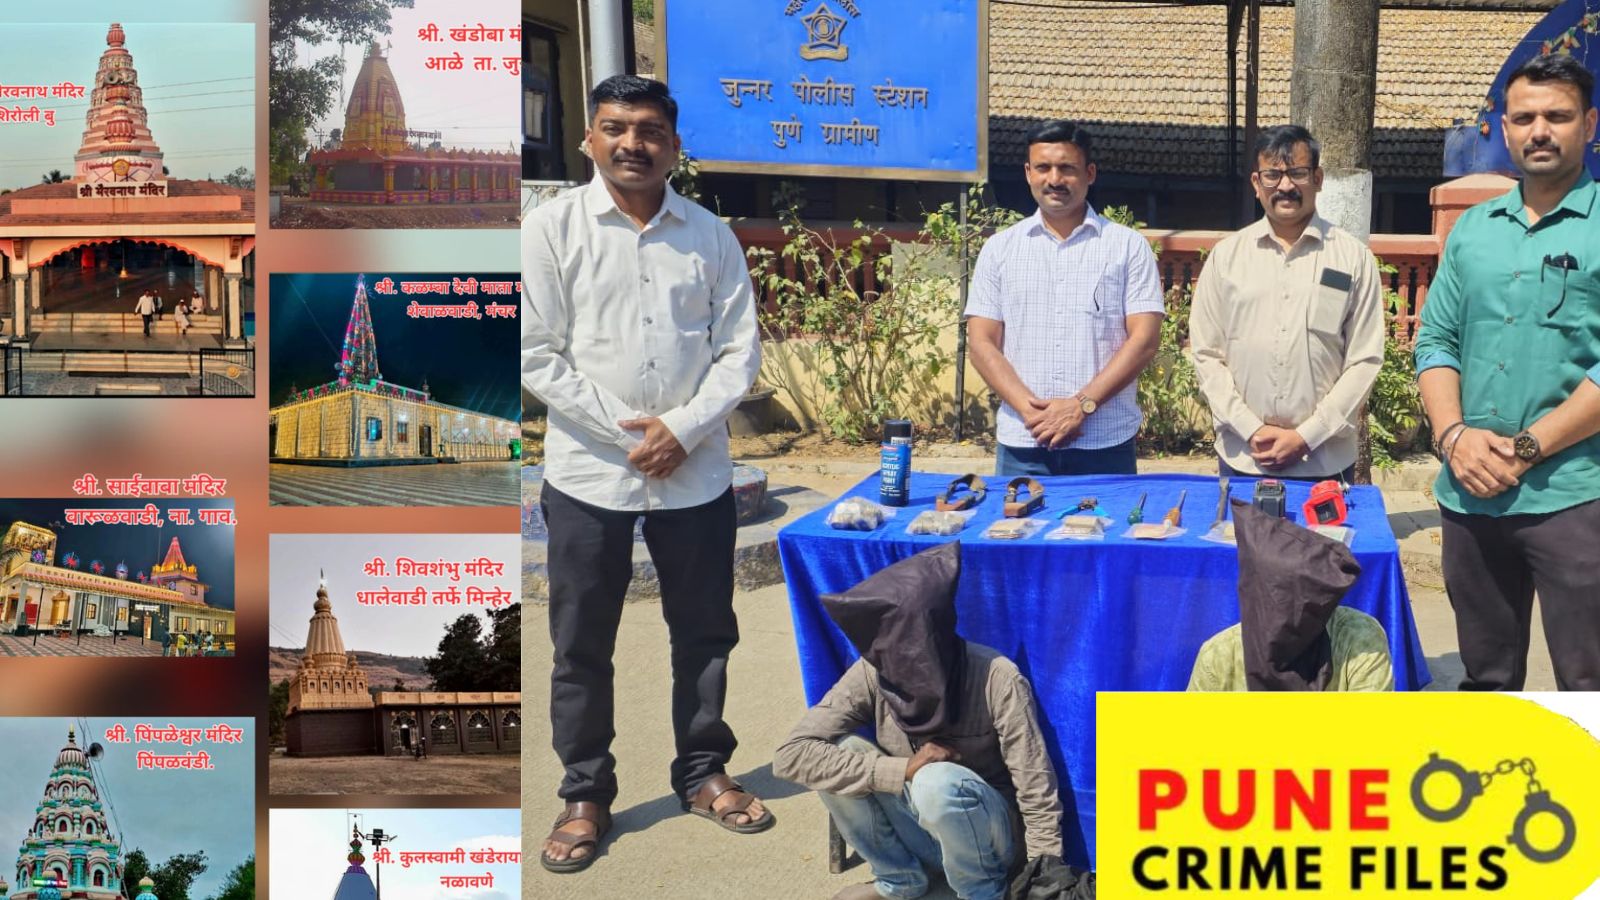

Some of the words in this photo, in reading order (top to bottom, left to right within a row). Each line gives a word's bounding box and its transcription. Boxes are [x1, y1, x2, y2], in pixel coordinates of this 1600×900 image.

[720, 77, 773, 108] जुन्नर
[791, 73, 855, 106] पोलीस
[872, 78, 929, 109] स्टेशन
[769, 115, 803, 148] पुणे
[819, 118, 880, 147] ग्रामीण
[139, 182, 165, 196] मंदिर
